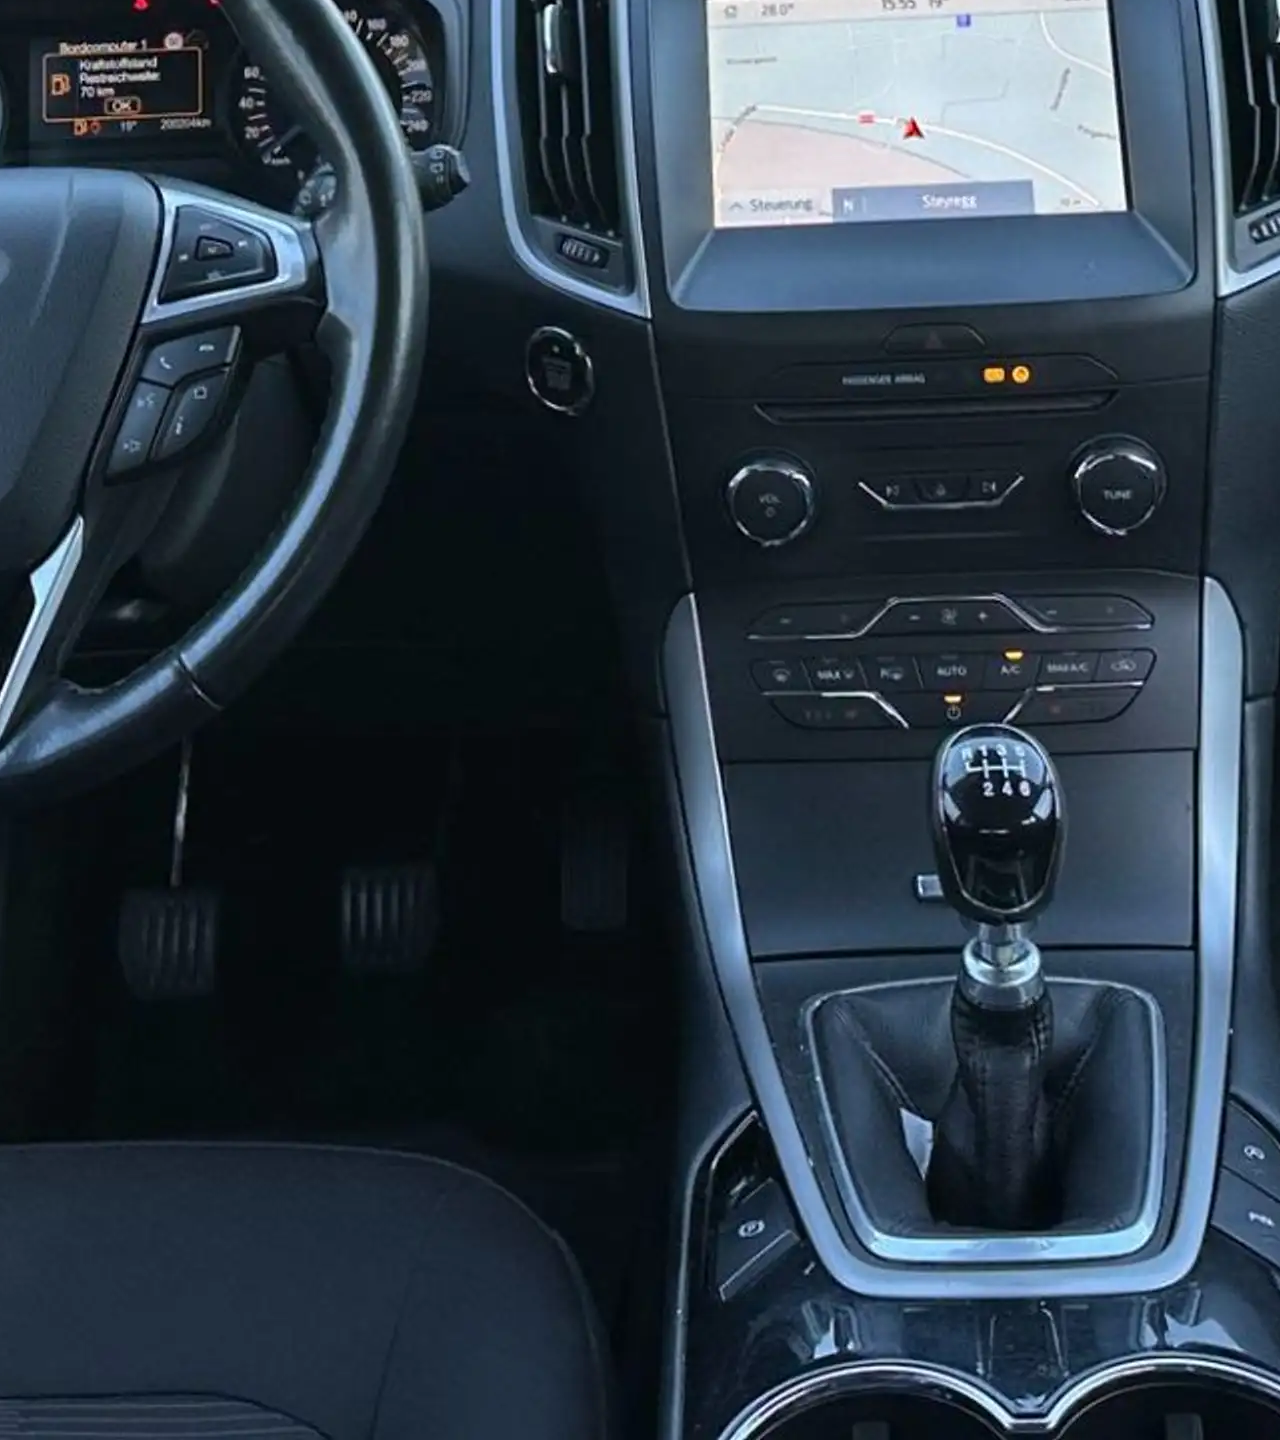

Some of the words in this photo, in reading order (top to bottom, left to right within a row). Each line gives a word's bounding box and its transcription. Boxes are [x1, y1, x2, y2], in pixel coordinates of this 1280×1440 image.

[922, 193, 978, 210] Steyregg
[1103, 488, 1132, 500] TUNE
[936, 665, 968, 677] AUTO
[1000, 664, 1021, 675] A/C
[982, 780, 996, 798] 2
[1001, 780, 1014, 797] 4
